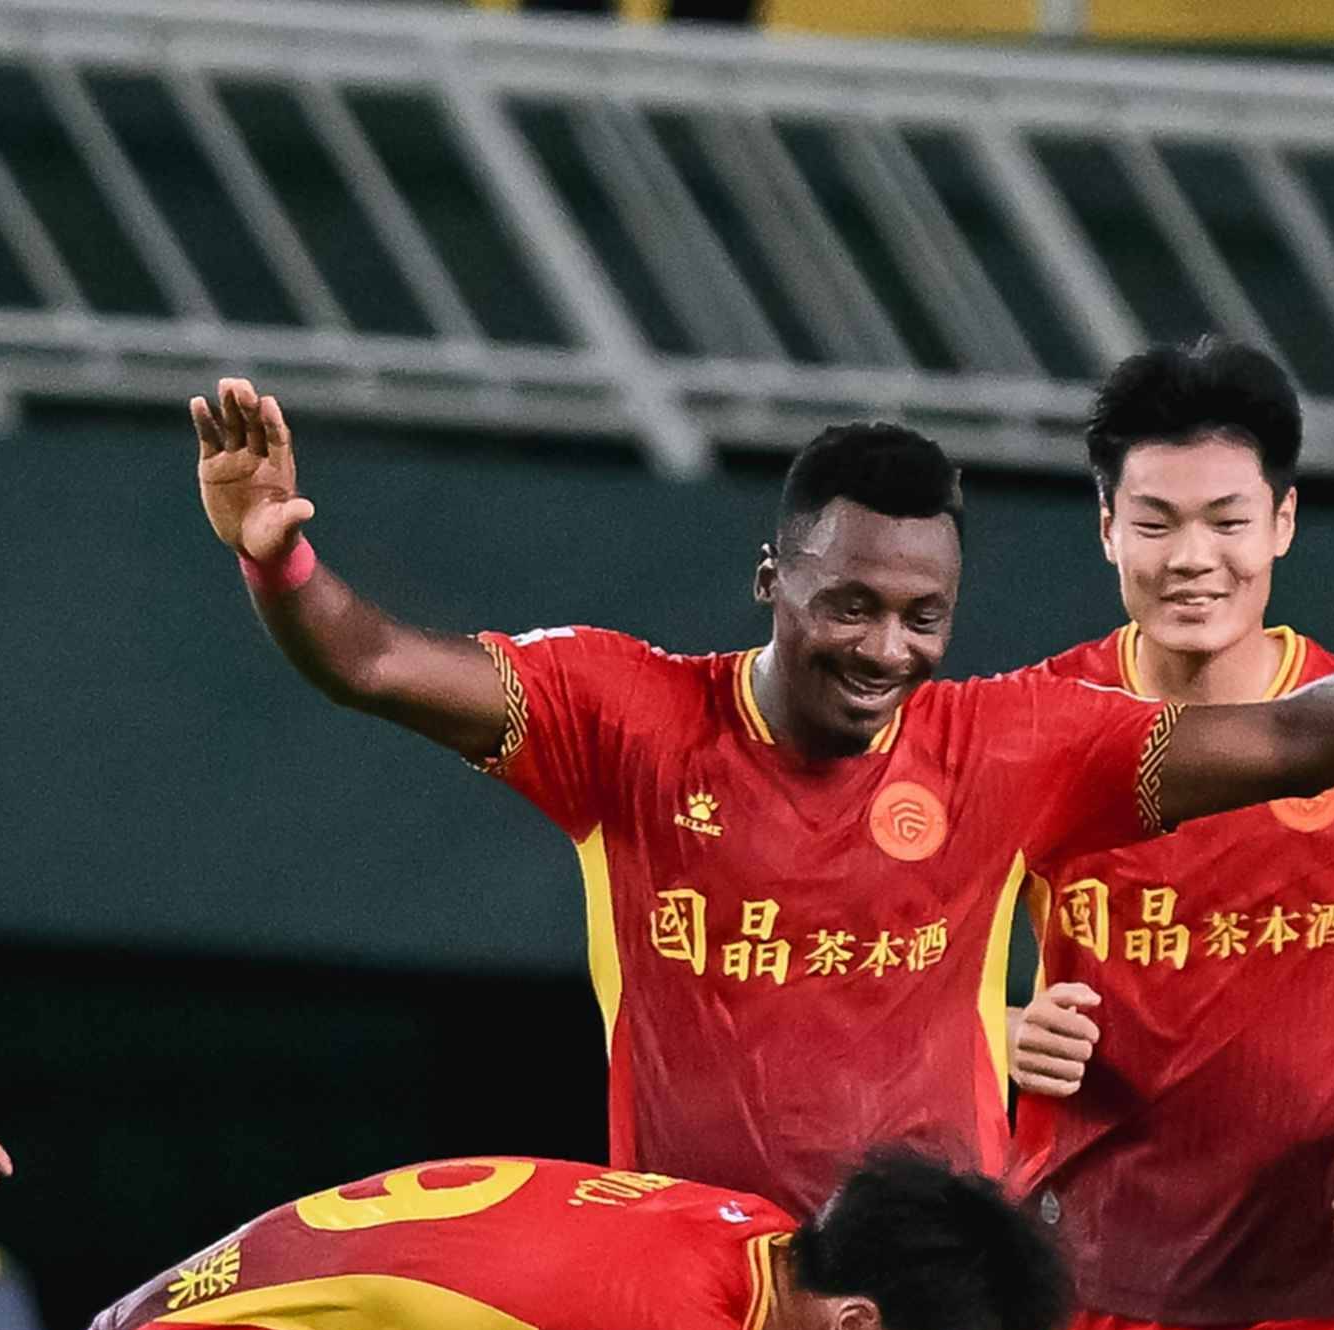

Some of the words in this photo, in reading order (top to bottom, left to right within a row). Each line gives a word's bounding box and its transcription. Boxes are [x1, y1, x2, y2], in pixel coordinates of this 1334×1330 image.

[674, 813, 723, 837] KELME
[651, 888, 948, 985] 國晶茶本酒
[296, 1158, 537, 1232] 9
